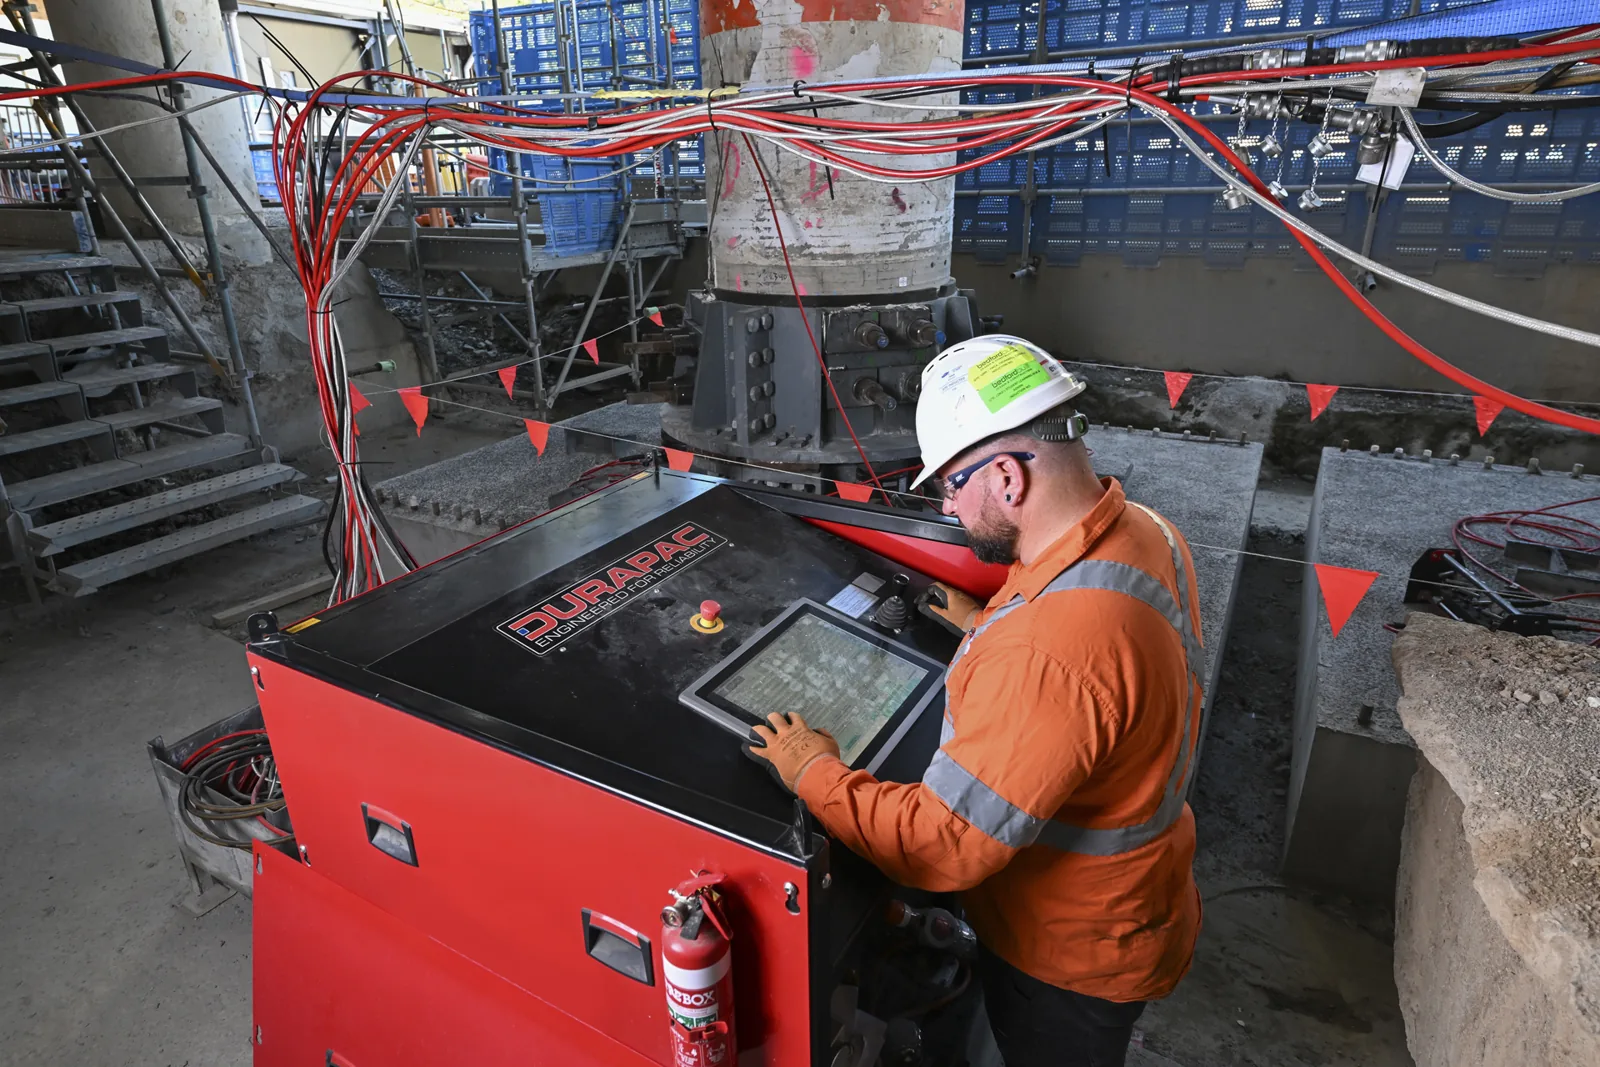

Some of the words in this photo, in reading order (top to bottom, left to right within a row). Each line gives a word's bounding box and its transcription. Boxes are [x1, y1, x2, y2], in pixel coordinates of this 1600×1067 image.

[508, 525, 710, 642] DURAPAC
[535, 590, 630, 648] ENGINEERED
[627, 574, 657, 593] FOR
[654, 537, 718, 580] RELIABILITY
